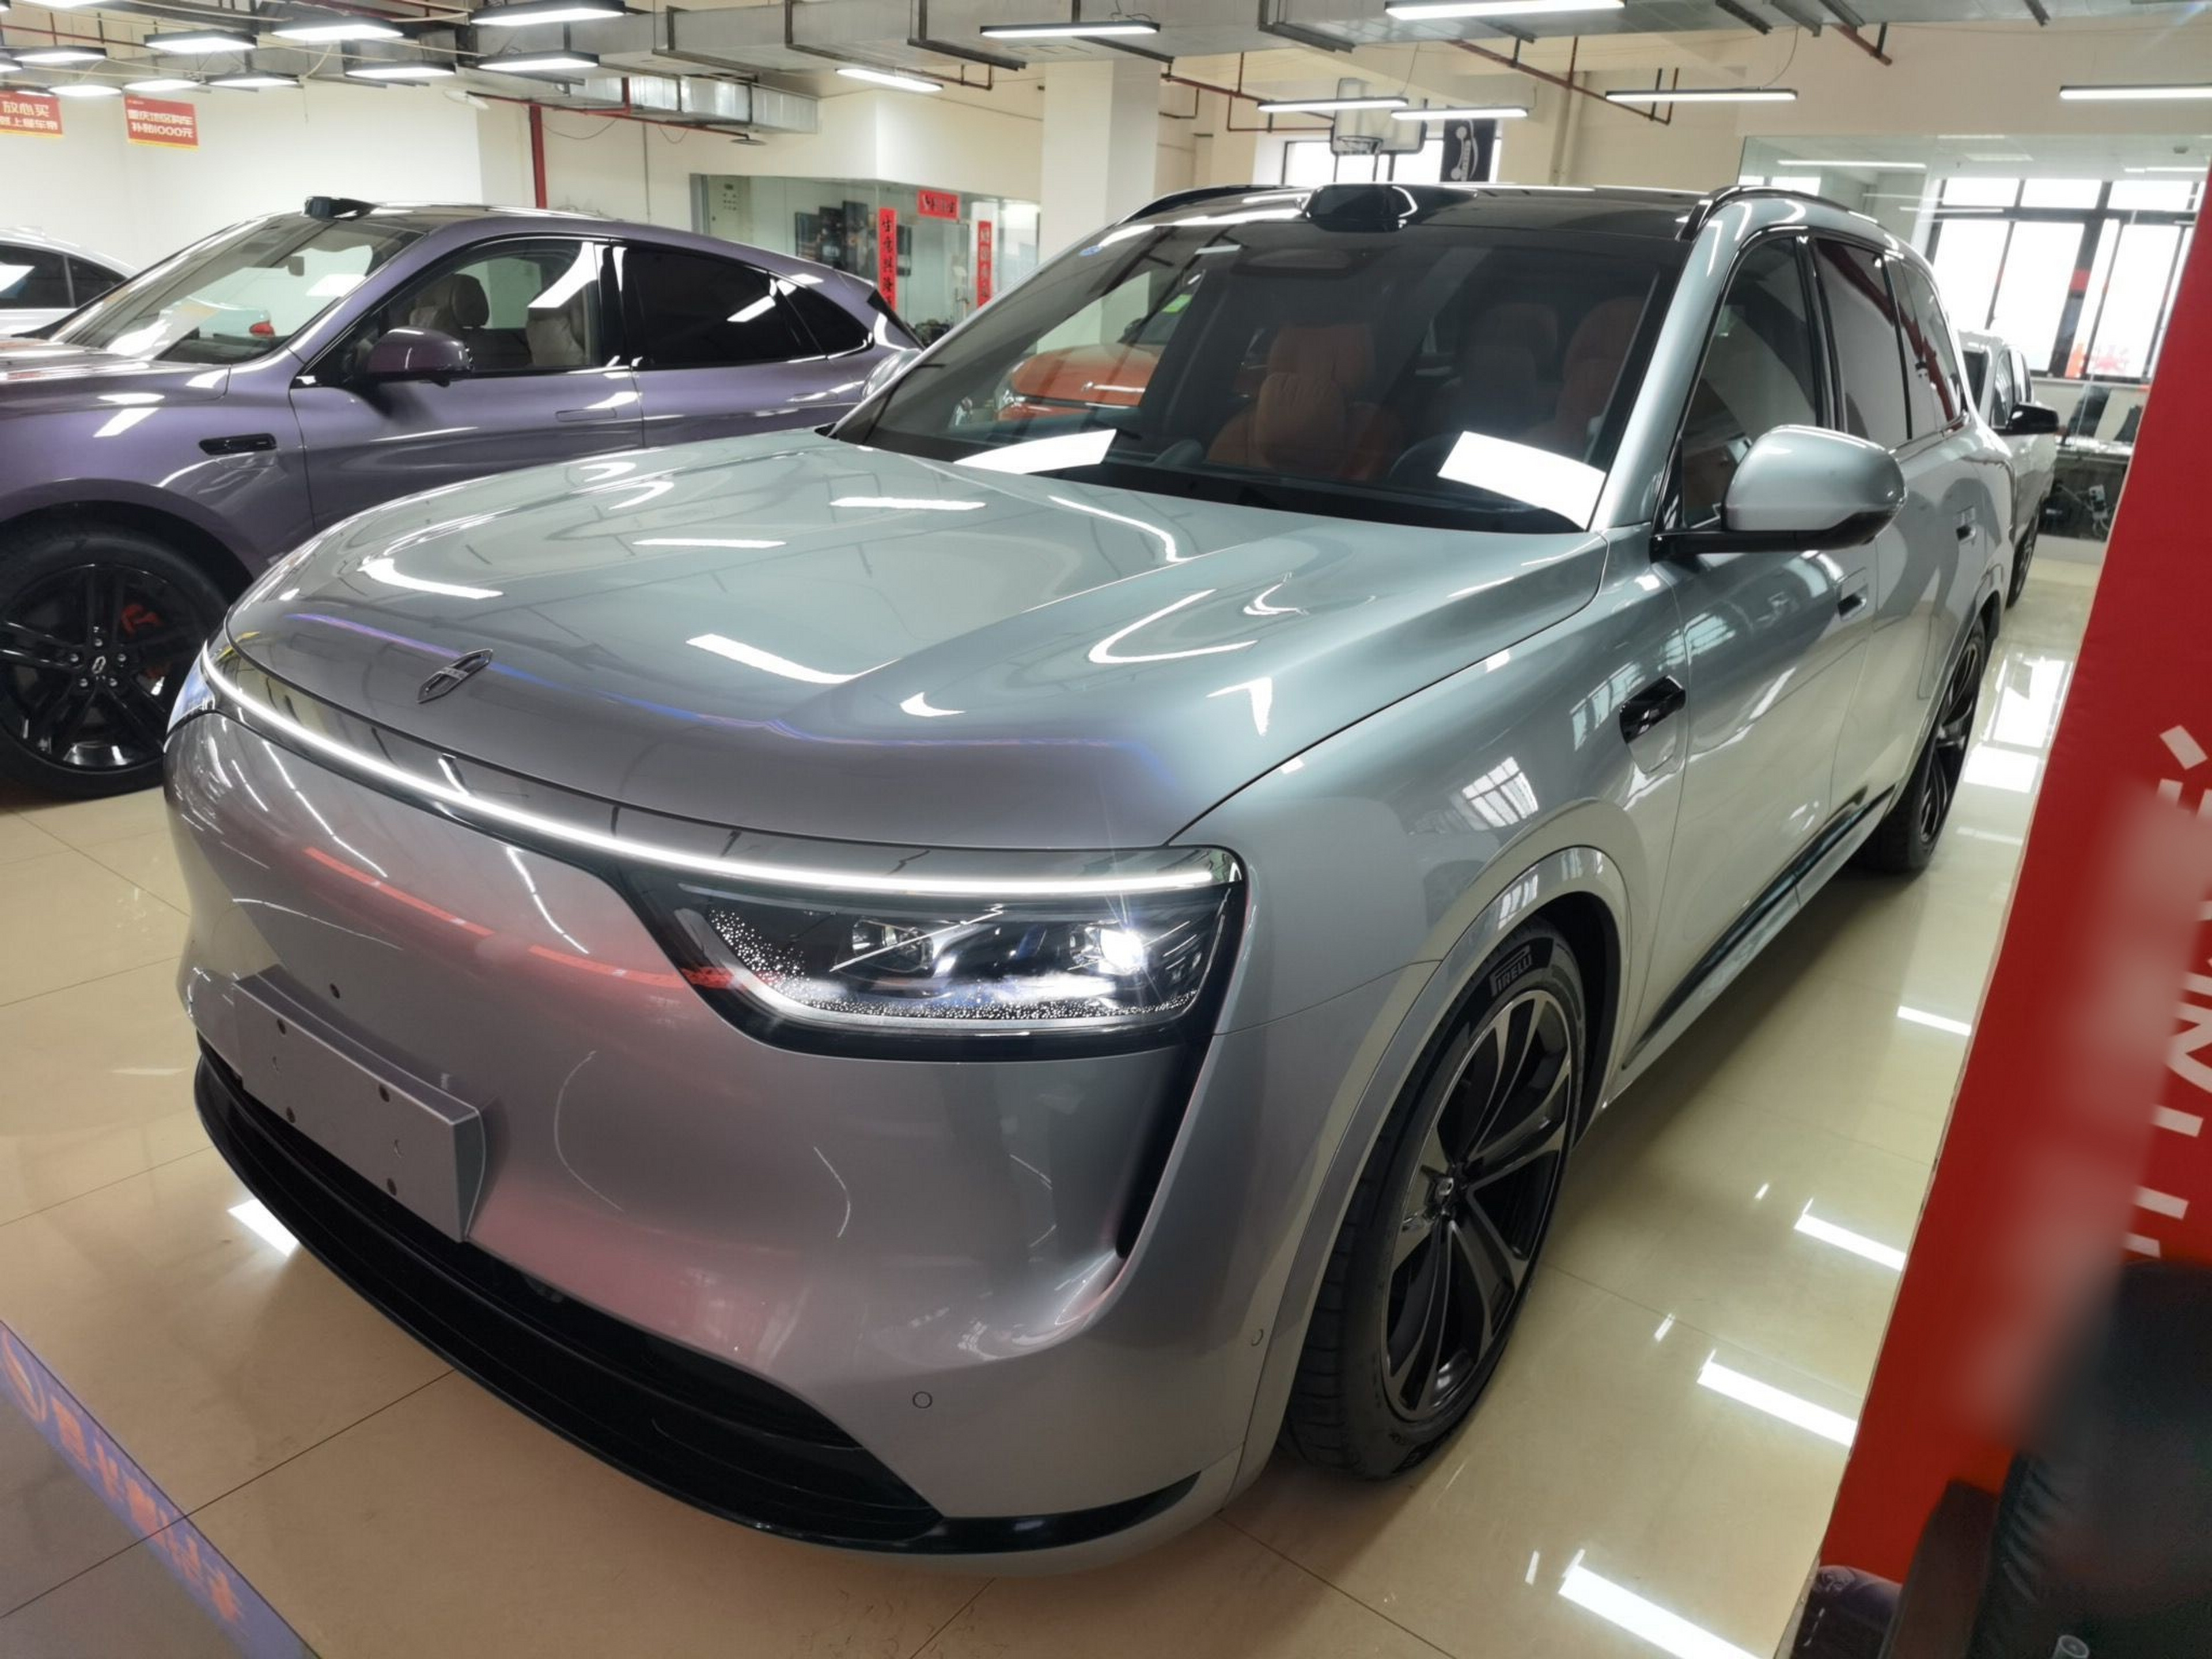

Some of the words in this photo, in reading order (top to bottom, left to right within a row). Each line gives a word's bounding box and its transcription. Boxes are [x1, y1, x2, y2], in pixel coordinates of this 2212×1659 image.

[2, 101, 50, 117] 放心买
[1488, 945, 1532, 997] PIRELLI
